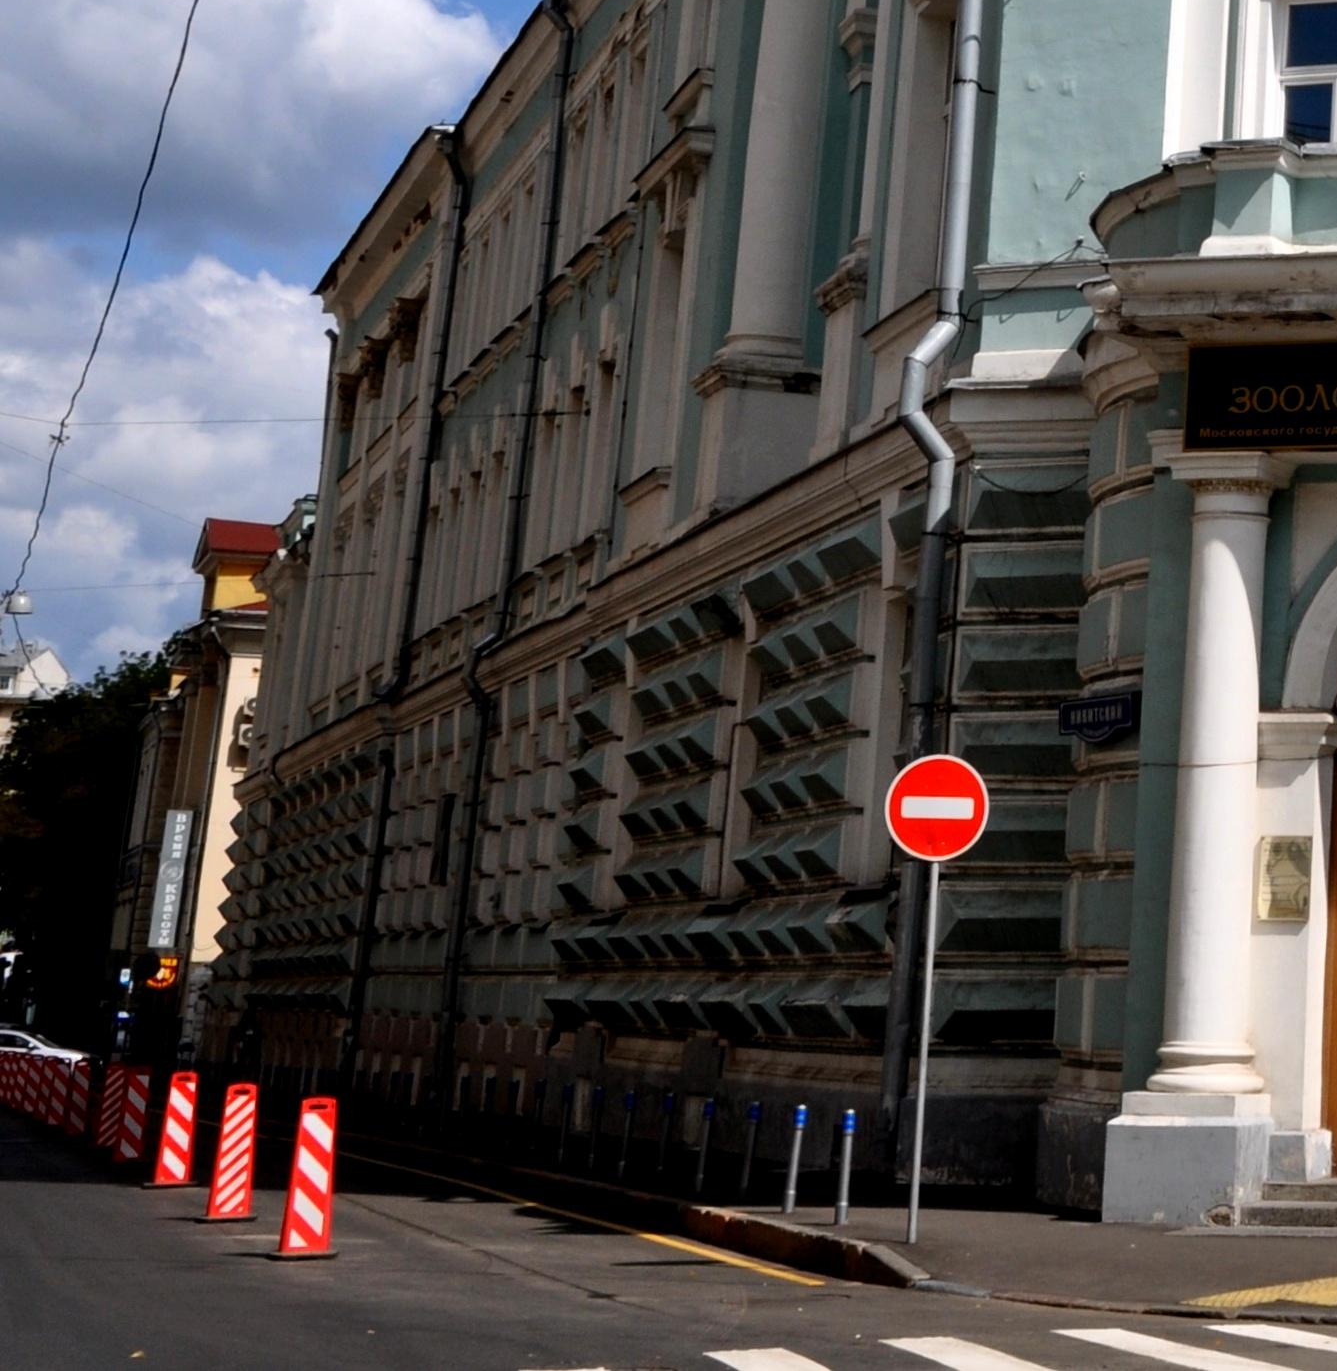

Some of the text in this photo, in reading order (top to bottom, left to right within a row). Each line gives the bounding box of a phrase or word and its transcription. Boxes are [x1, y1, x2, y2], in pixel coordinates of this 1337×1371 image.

[1199, 425, 1294, 438] Московского
[171, 813, 188, 859] Время
[158, 883, 178, 946] Красоты
